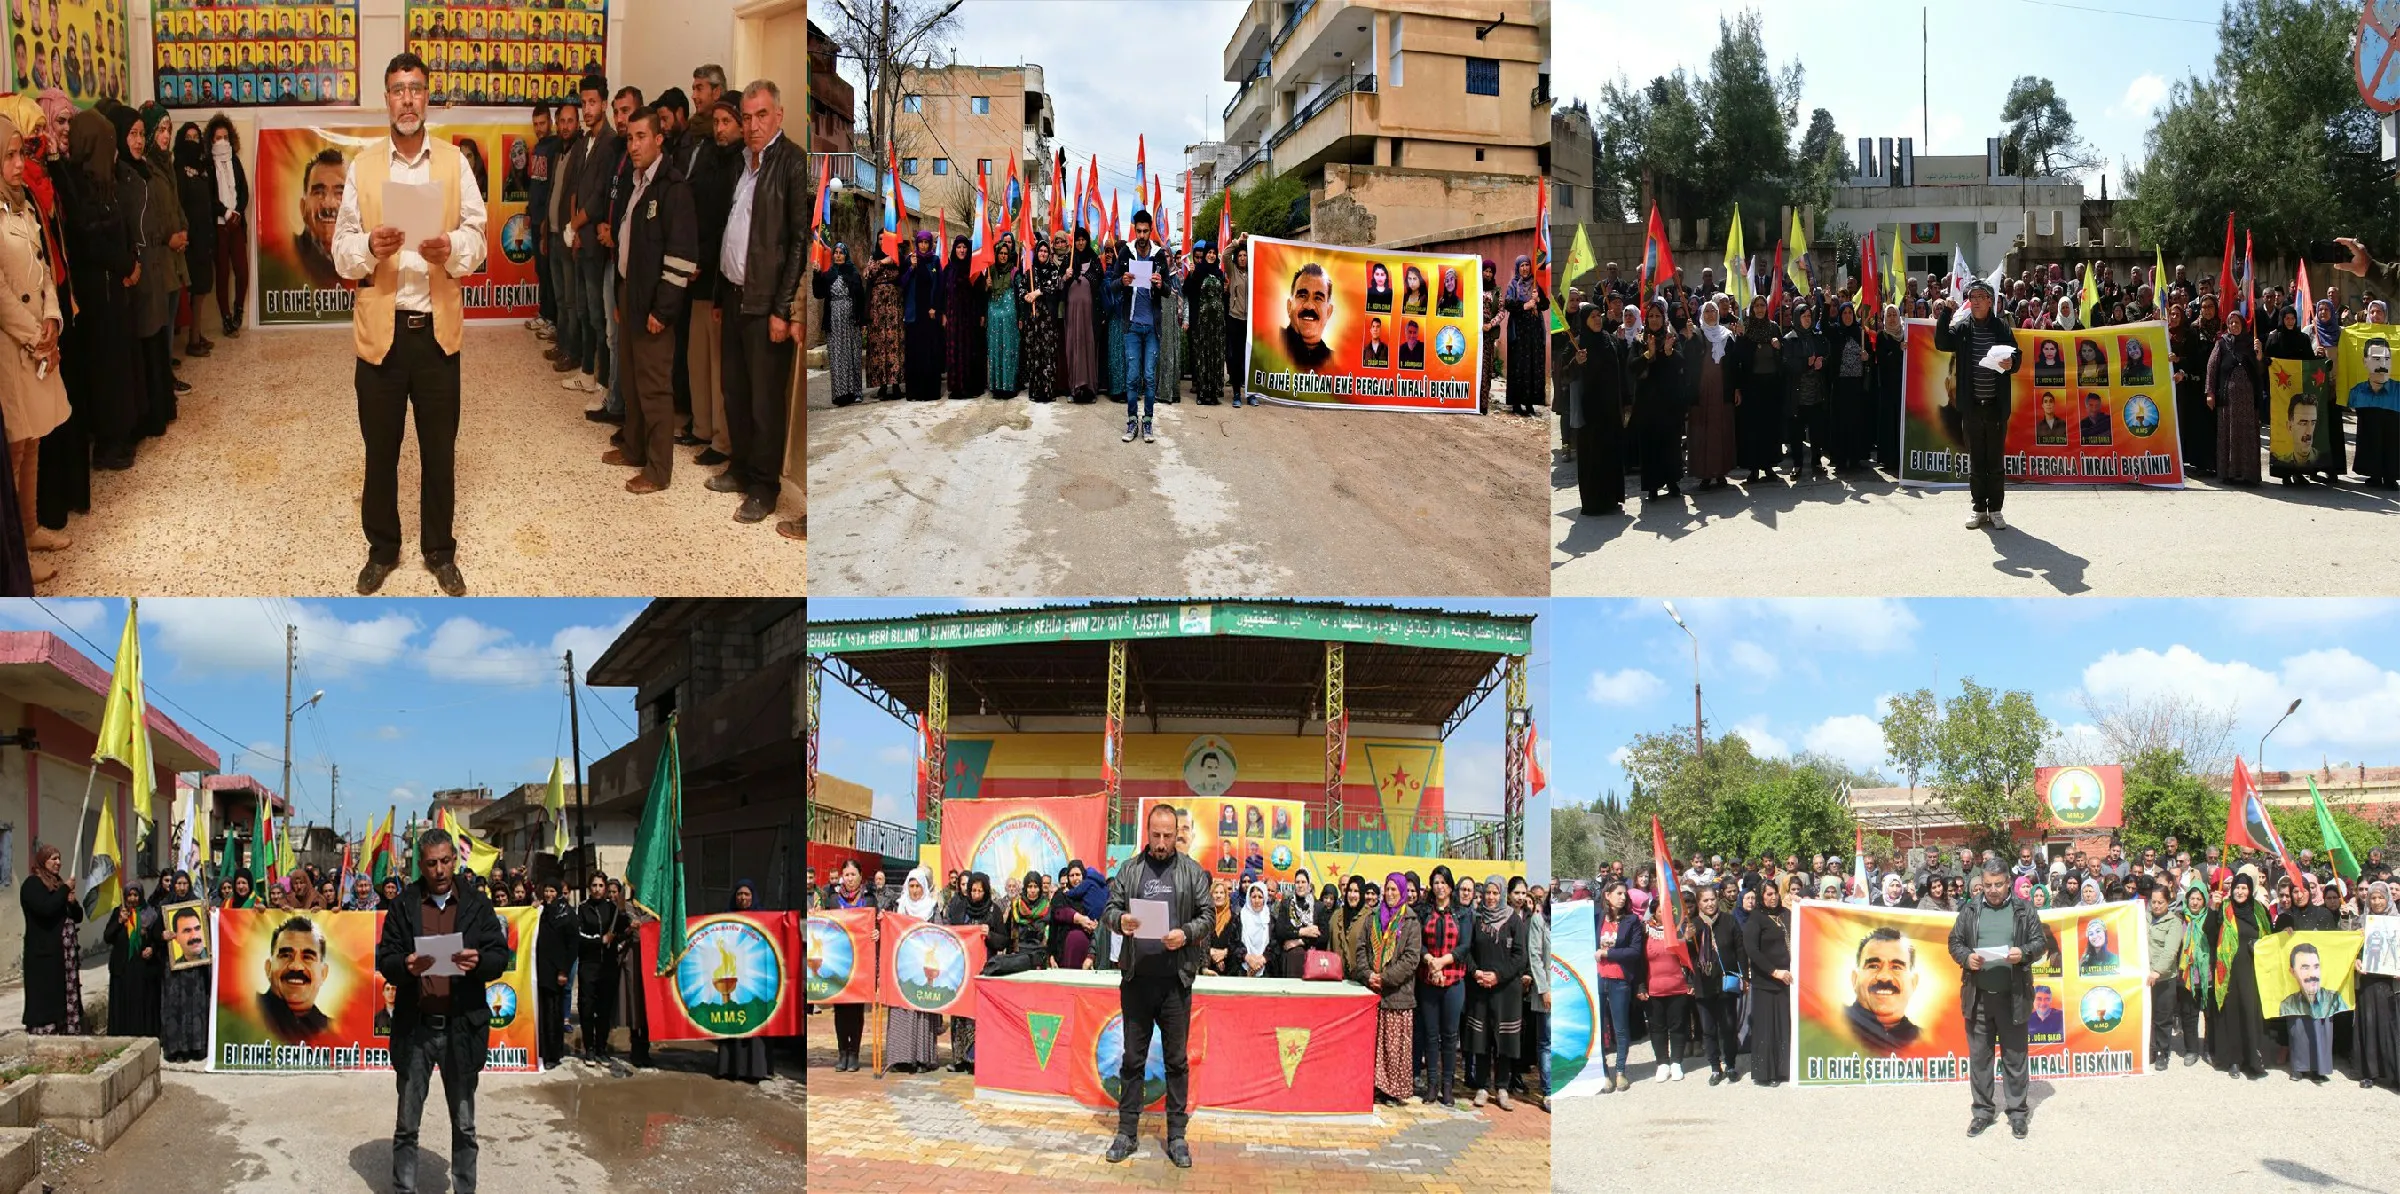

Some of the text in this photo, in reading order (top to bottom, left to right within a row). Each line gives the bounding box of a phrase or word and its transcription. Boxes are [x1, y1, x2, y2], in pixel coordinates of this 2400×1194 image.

[266, 278, 540, 318] BI RIHÊ ŞEHÎDA RALÎ BIŞKÎNI
[1254, 369, 1470, 403] BI RIHÊ ŞEHÎDAN EMÊ PERGALA ÎMRALÎ BIŞKÎNIN
[1910, 450, 1923, 471] BI
[1925, 447, 1951, 473] RIHÊ
[2004, 450, 2026, 476] EMÊ
[2029, 455, 2078, 477] PERGALA
[2080, 451, 2118, 476] ÎMRALÎ
[2121, 450, 2172, 481] BIŞKÎNIN
[868, 625, 889, 646] HERÎ
[891, 627, 920, 643] BILIND
[930, 625, 939, 641] BI
[940, 623, 962, 640] NIRK
[710, 1010, 747, 1025] M.M.Ş
[223, 1043, 239, 1066] BI
[241, 1040, 272, 1066] RIHÊ
[275, 1041, 330, 1067] ŞEHÎDAN
[334, 1041, 359, 1067] EMÊ
[486, 1041, 528, 1068] ŞKÎNIN
[1808, 1056, 1823, 1079] BI
[1827, 1052, 1861, 1080] RIHÊ
[1864, 1052, 1924, 1084] ŞEHÎDAN
[1927, 1051, 1957, 1079] EMÊ
[2028, 1049, 2070, 1076] MRALÎ
